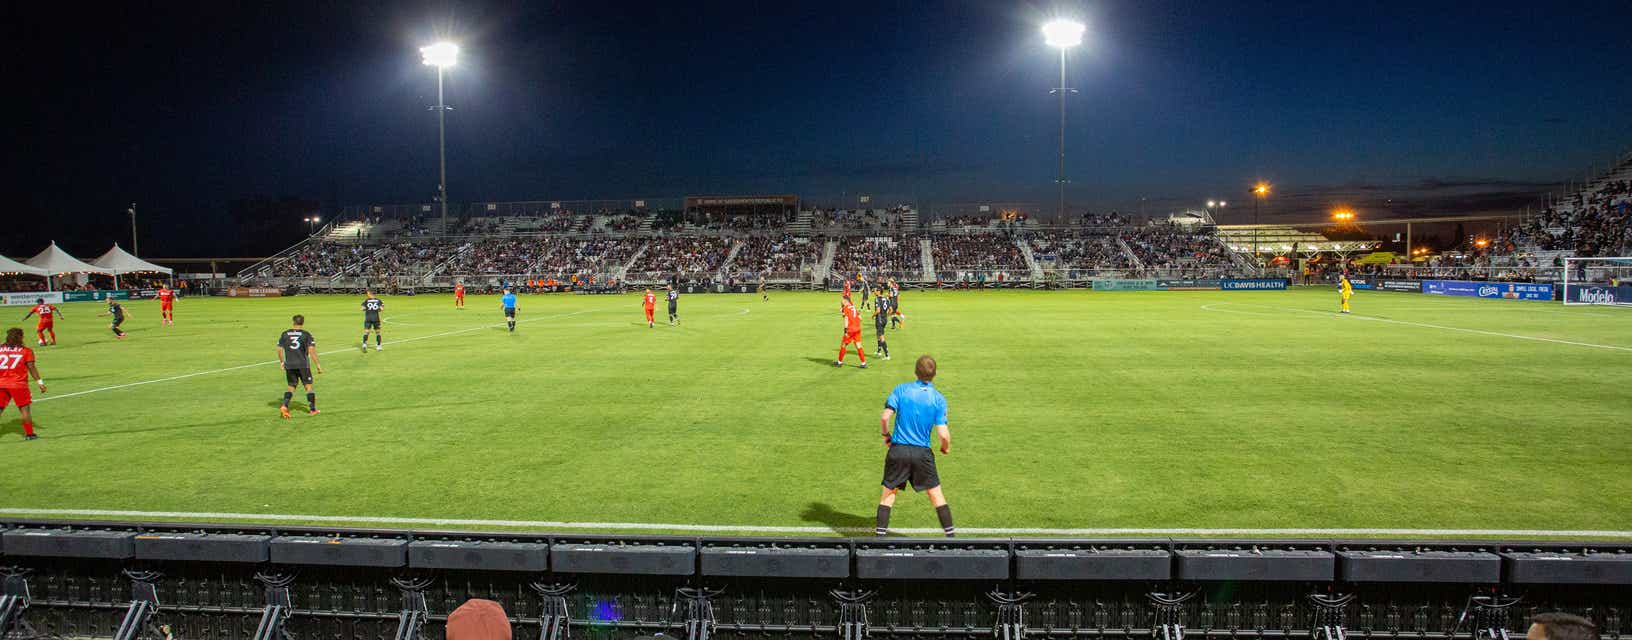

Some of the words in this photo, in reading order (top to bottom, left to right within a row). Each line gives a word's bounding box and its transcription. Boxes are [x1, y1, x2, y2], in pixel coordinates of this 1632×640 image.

[1235, 281, 1255, 289] DAVIS
[1256, 281, 1284, 289] HEALTH
[1580, 288, 1614, 303] Modelo
[366, 302, 379, 311] 96
[289, 336, 301, 350] 3
[0, 354, 23, 370] 27
